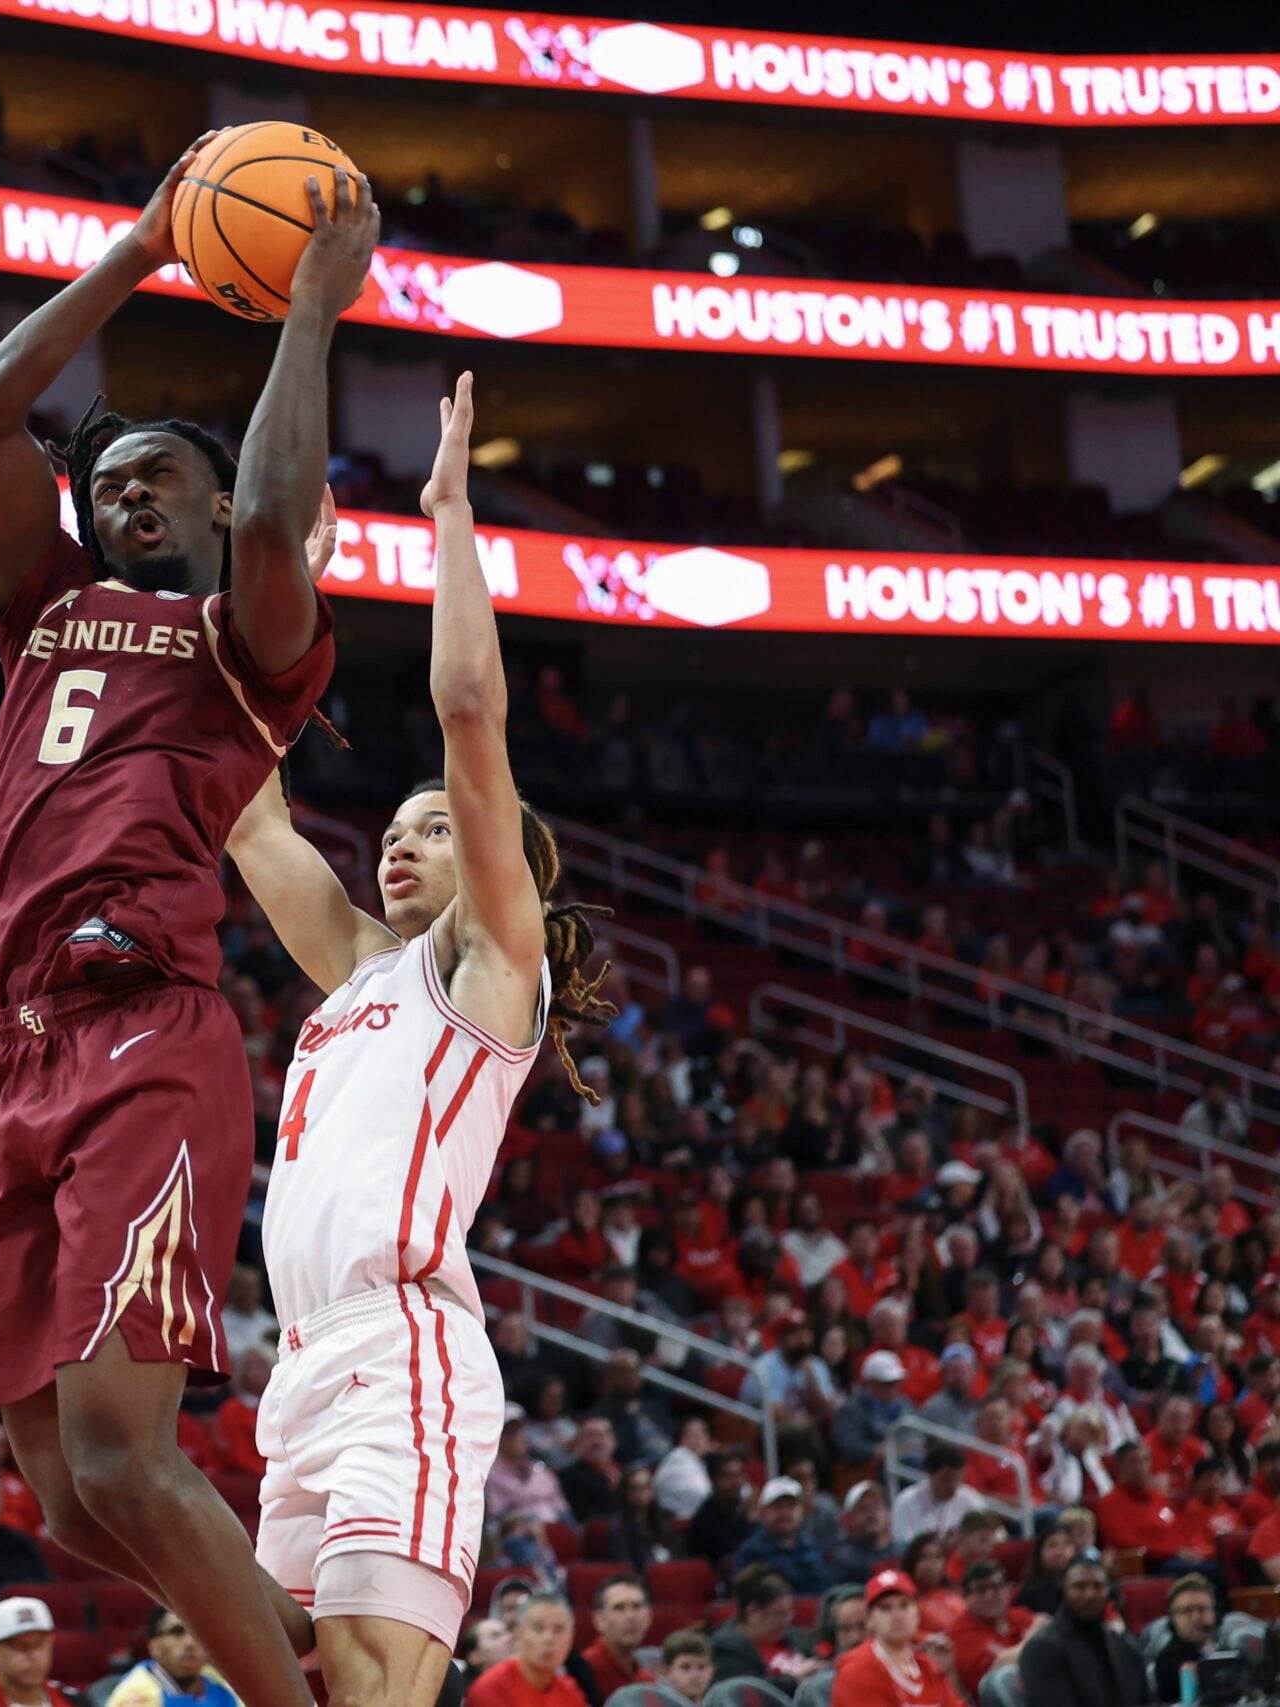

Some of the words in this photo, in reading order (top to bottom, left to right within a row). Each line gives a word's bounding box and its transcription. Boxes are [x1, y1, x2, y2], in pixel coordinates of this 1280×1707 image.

[217, 0, 348, 61] HVAC
[351, 11, 498, 72] TEAM
[712, 39, 994, 109] HOUSTON'S
[1000, 61, 1054, 115] #1
[1060, 65, 1280, 116] TRUSTED
[2, 202, 138, 270] HVA
[651, 284, 954, 352] HOUSTON'S
[959, 300, 1016, 355] #1
[1022, 306, 1240, 364] TRUSTED
[365, 521, 520, 599] TEM
[824, 563, 1132, 628] HOUSTON'S
[1138, 573, 1196, 630] #1
[37, 669, 108, 765] 6
[277, 1068, 317, 1162] 4
